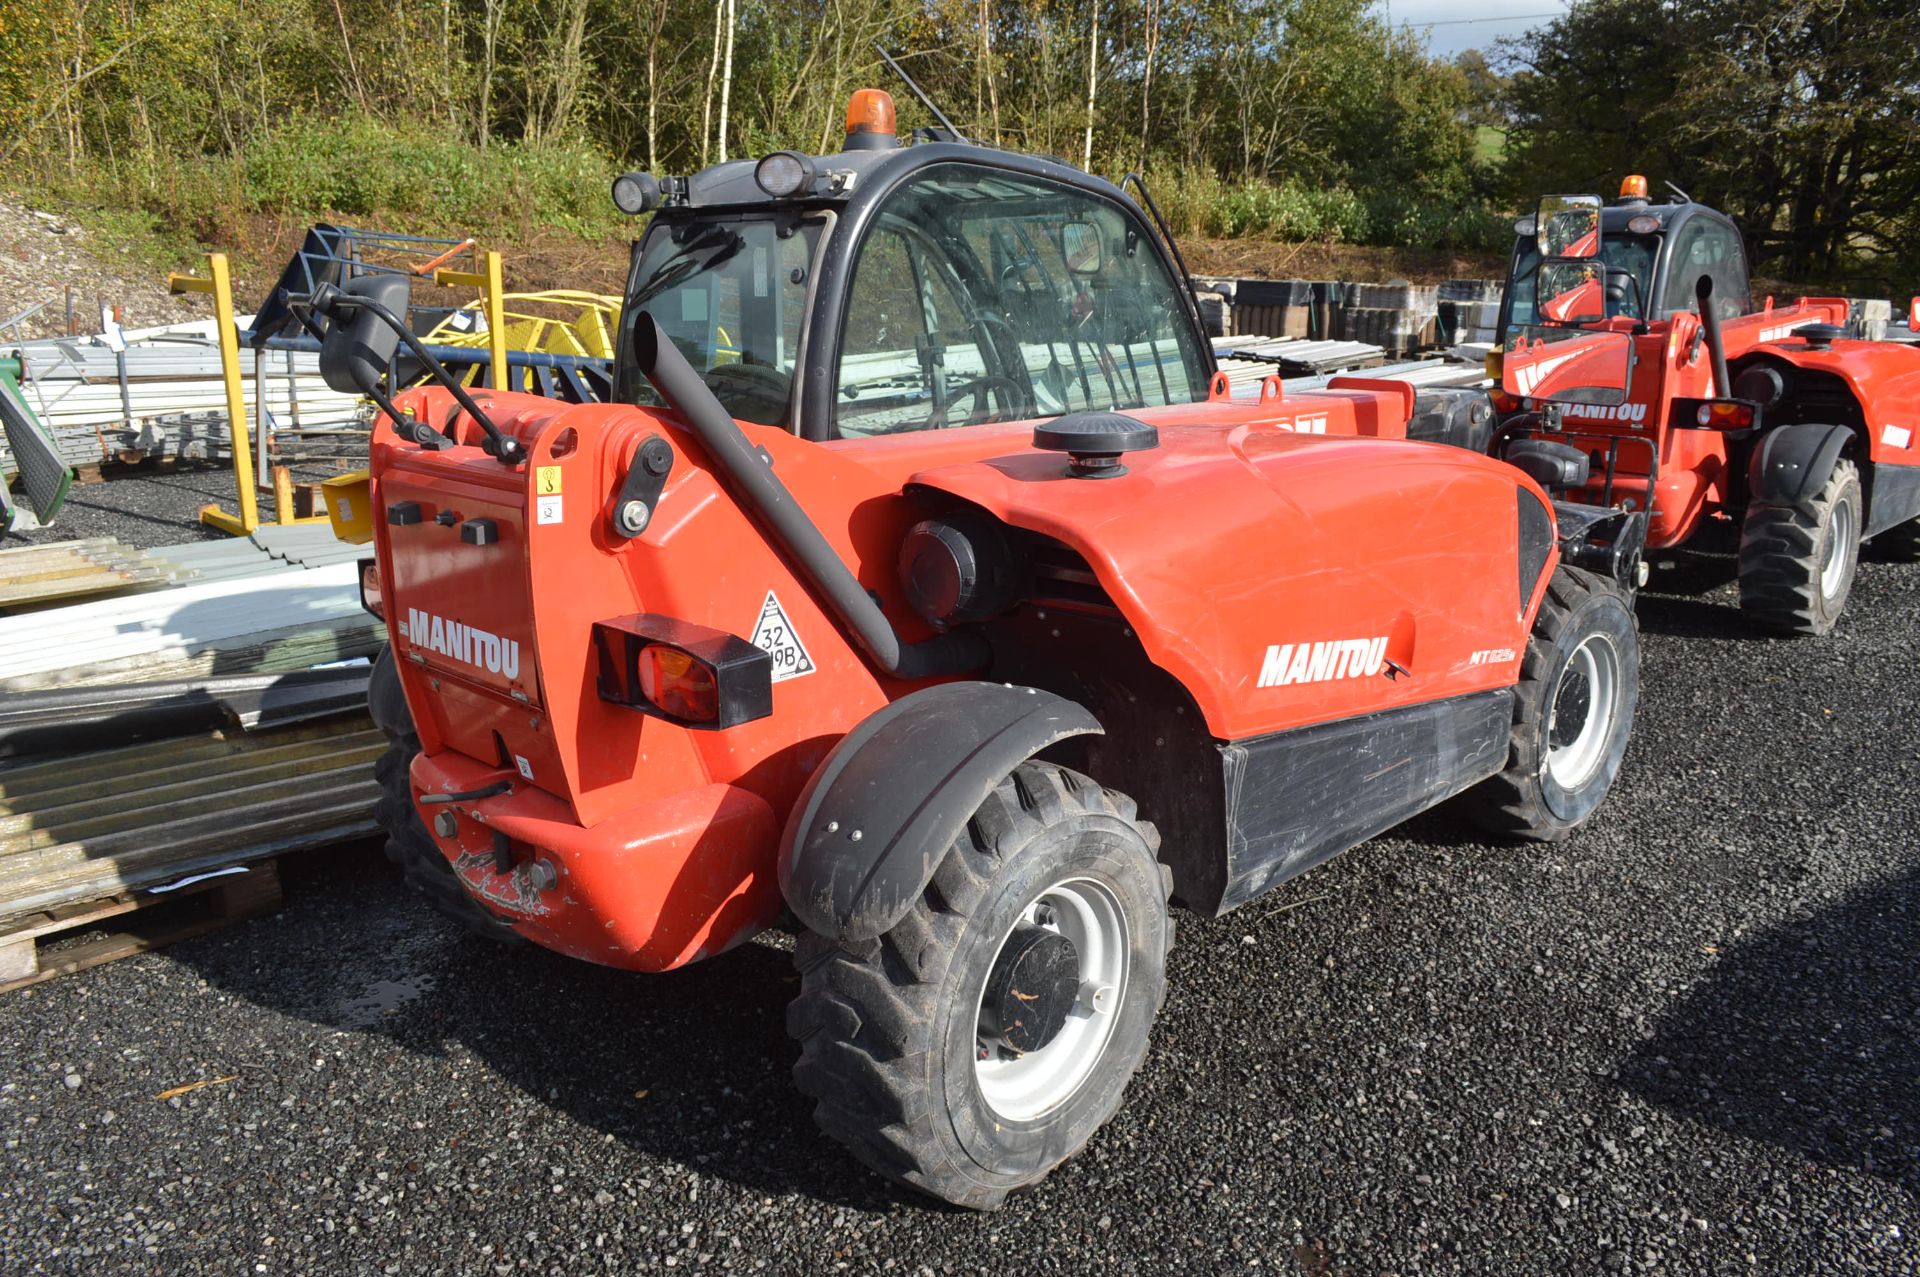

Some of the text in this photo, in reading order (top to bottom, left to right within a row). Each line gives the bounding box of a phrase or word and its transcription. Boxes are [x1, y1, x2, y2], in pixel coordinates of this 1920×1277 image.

[408, 607, 519, 680] MANITOU
[762, 626, 784, 649] 32
[1256, 636, 1389, 688] MANITOU
